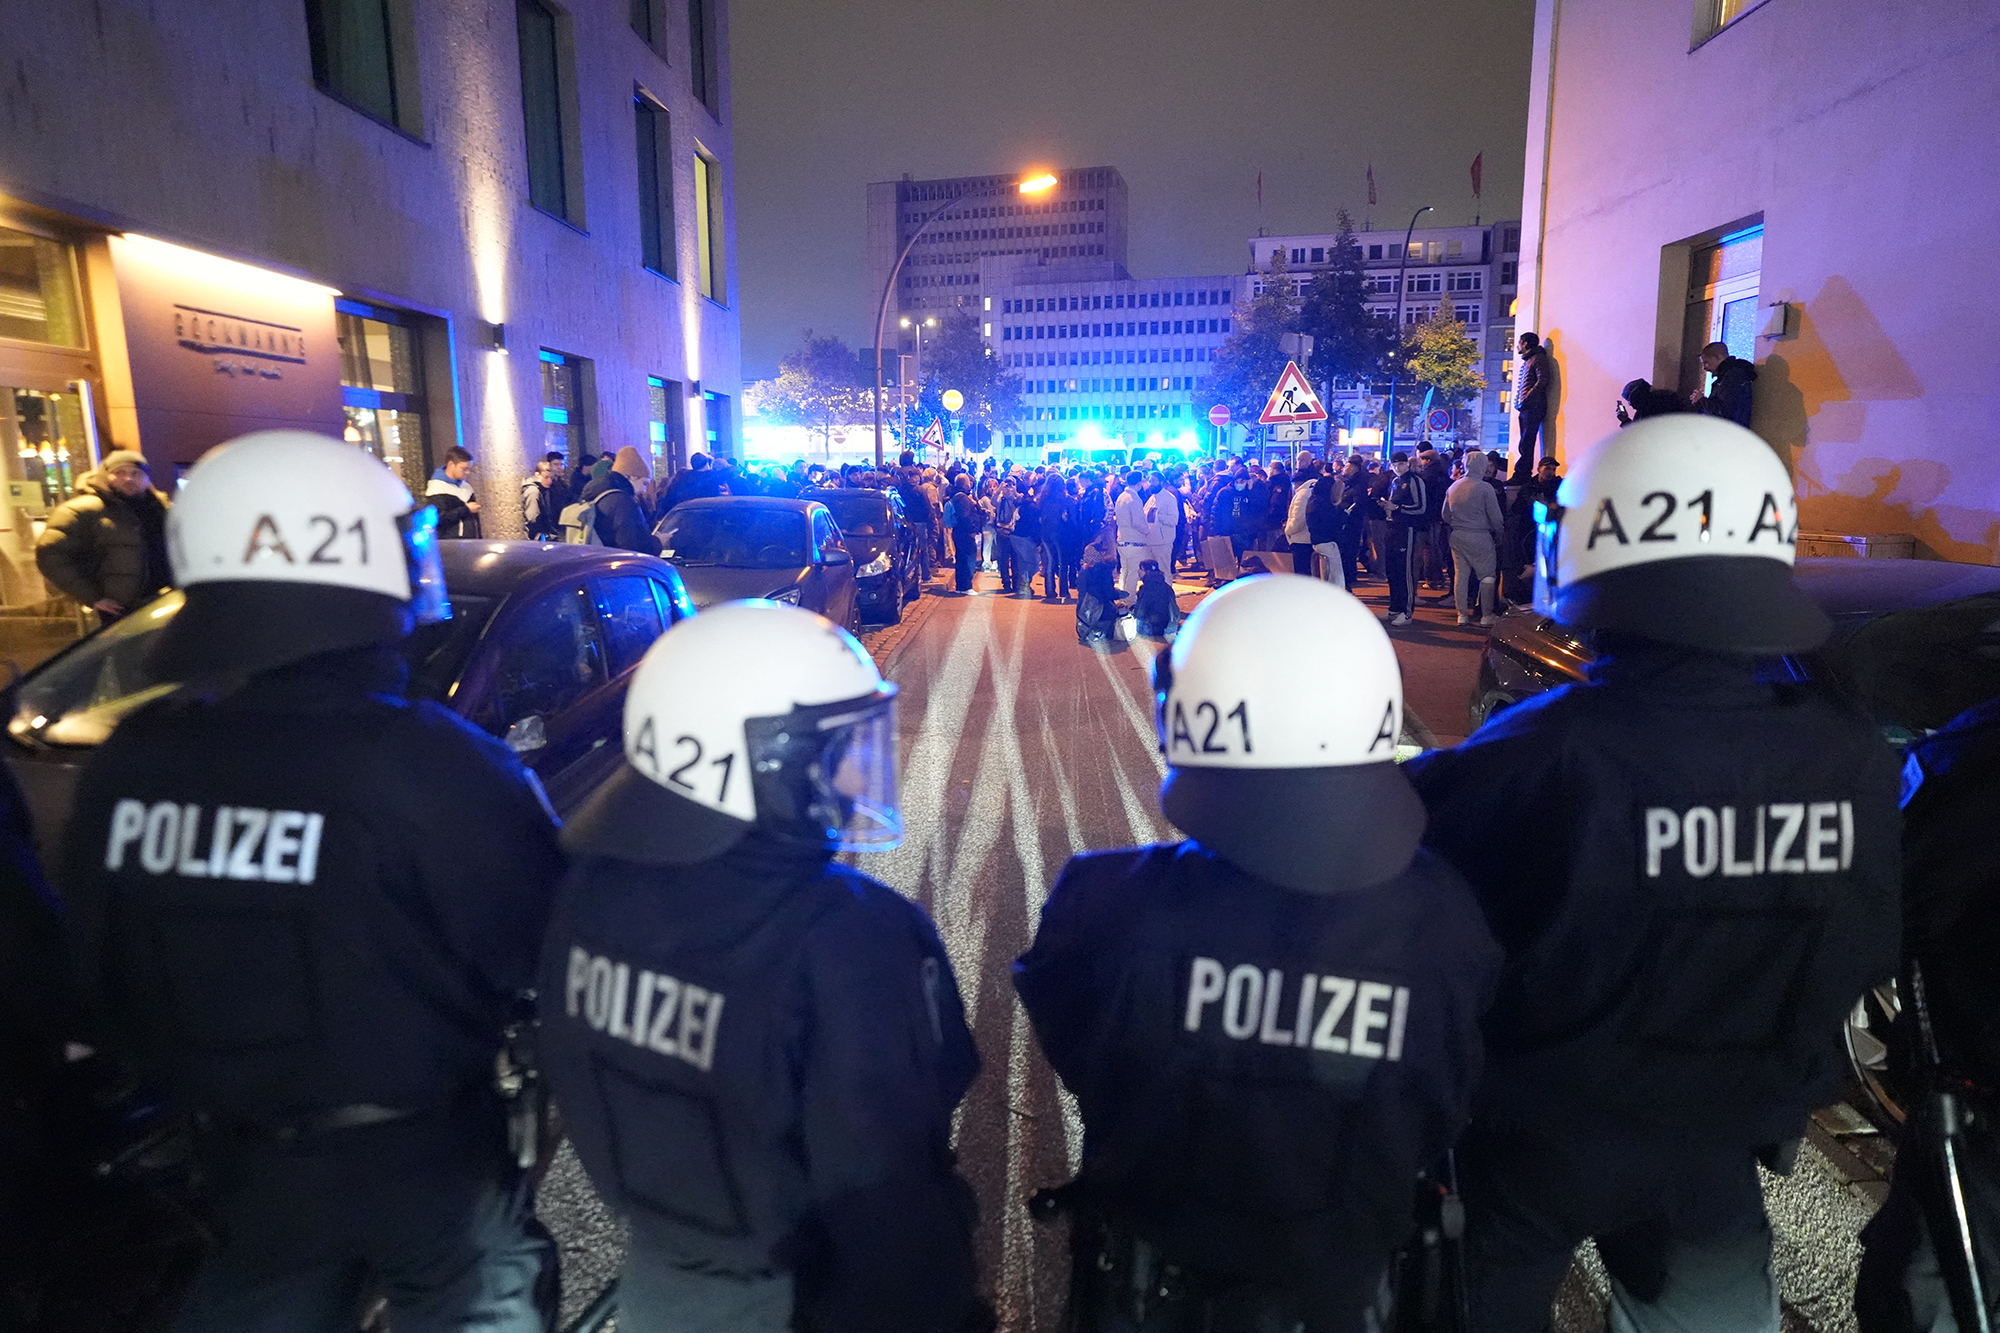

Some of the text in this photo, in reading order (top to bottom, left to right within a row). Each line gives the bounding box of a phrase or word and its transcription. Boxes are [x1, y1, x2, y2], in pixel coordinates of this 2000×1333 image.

[634, 716, 735, 803] A21
[1173, 699, 1255, 754] A21
[105, 797, 325, 886] POLIZEI
[1645, 800, 1855, 878] POLIZEI
[565, 946, 726, 1072] POLIZEI
[1183, 955, 1411, 1062] POLIZEI
